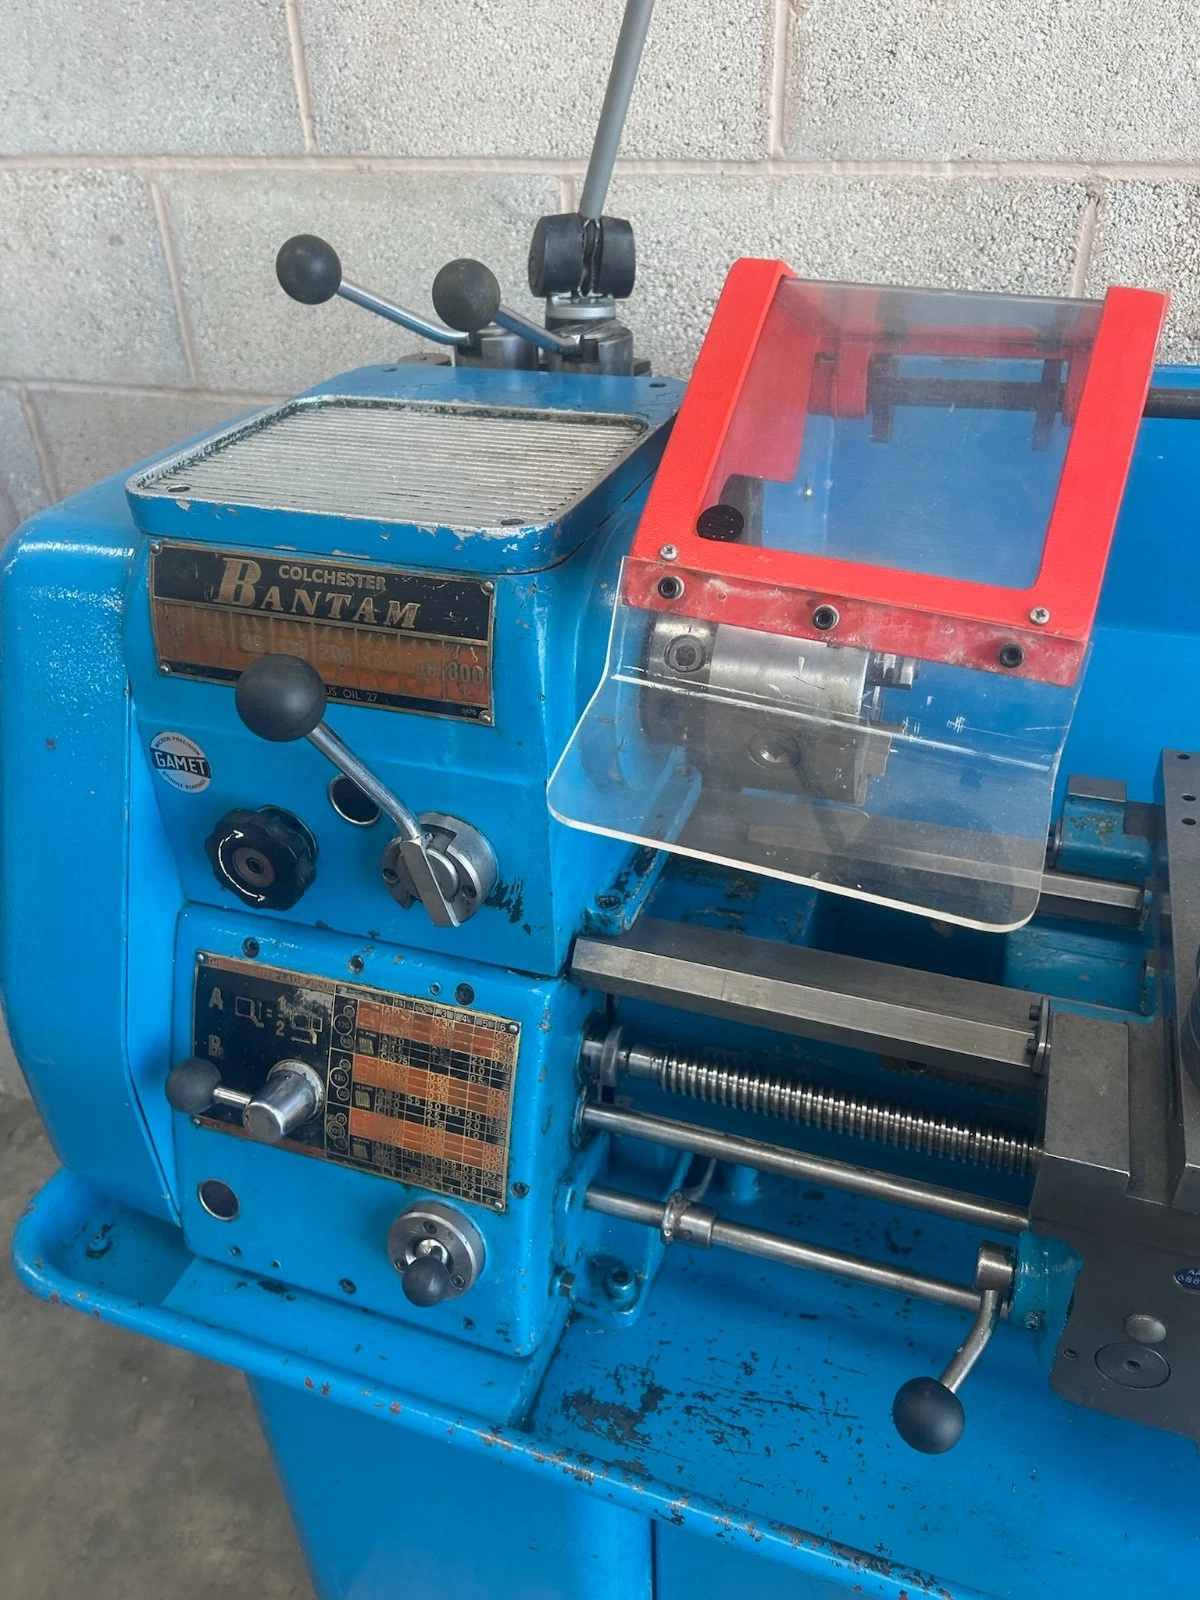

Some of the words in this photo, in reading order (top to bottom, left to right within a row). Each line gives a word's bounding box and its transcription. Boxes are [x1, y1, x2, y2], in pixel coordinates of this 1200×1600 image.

[278, 564, 387, 591] COLCHESTER
[212, 557, 421, 629] BANTAM
[447, 661, 484, 684] 800
[342, 689, 361, 700] OIL
[366, 692, 378, 702] 27
[154, 751, 206, 775] GAMET
[208, 986, 224, 1011] A
[441, 1010, 447, 1018] 3
[276, 1020, 285, 1036] 2
[208, 1034, 223, 1057] B
[380, 1052, 387, 1060] C
